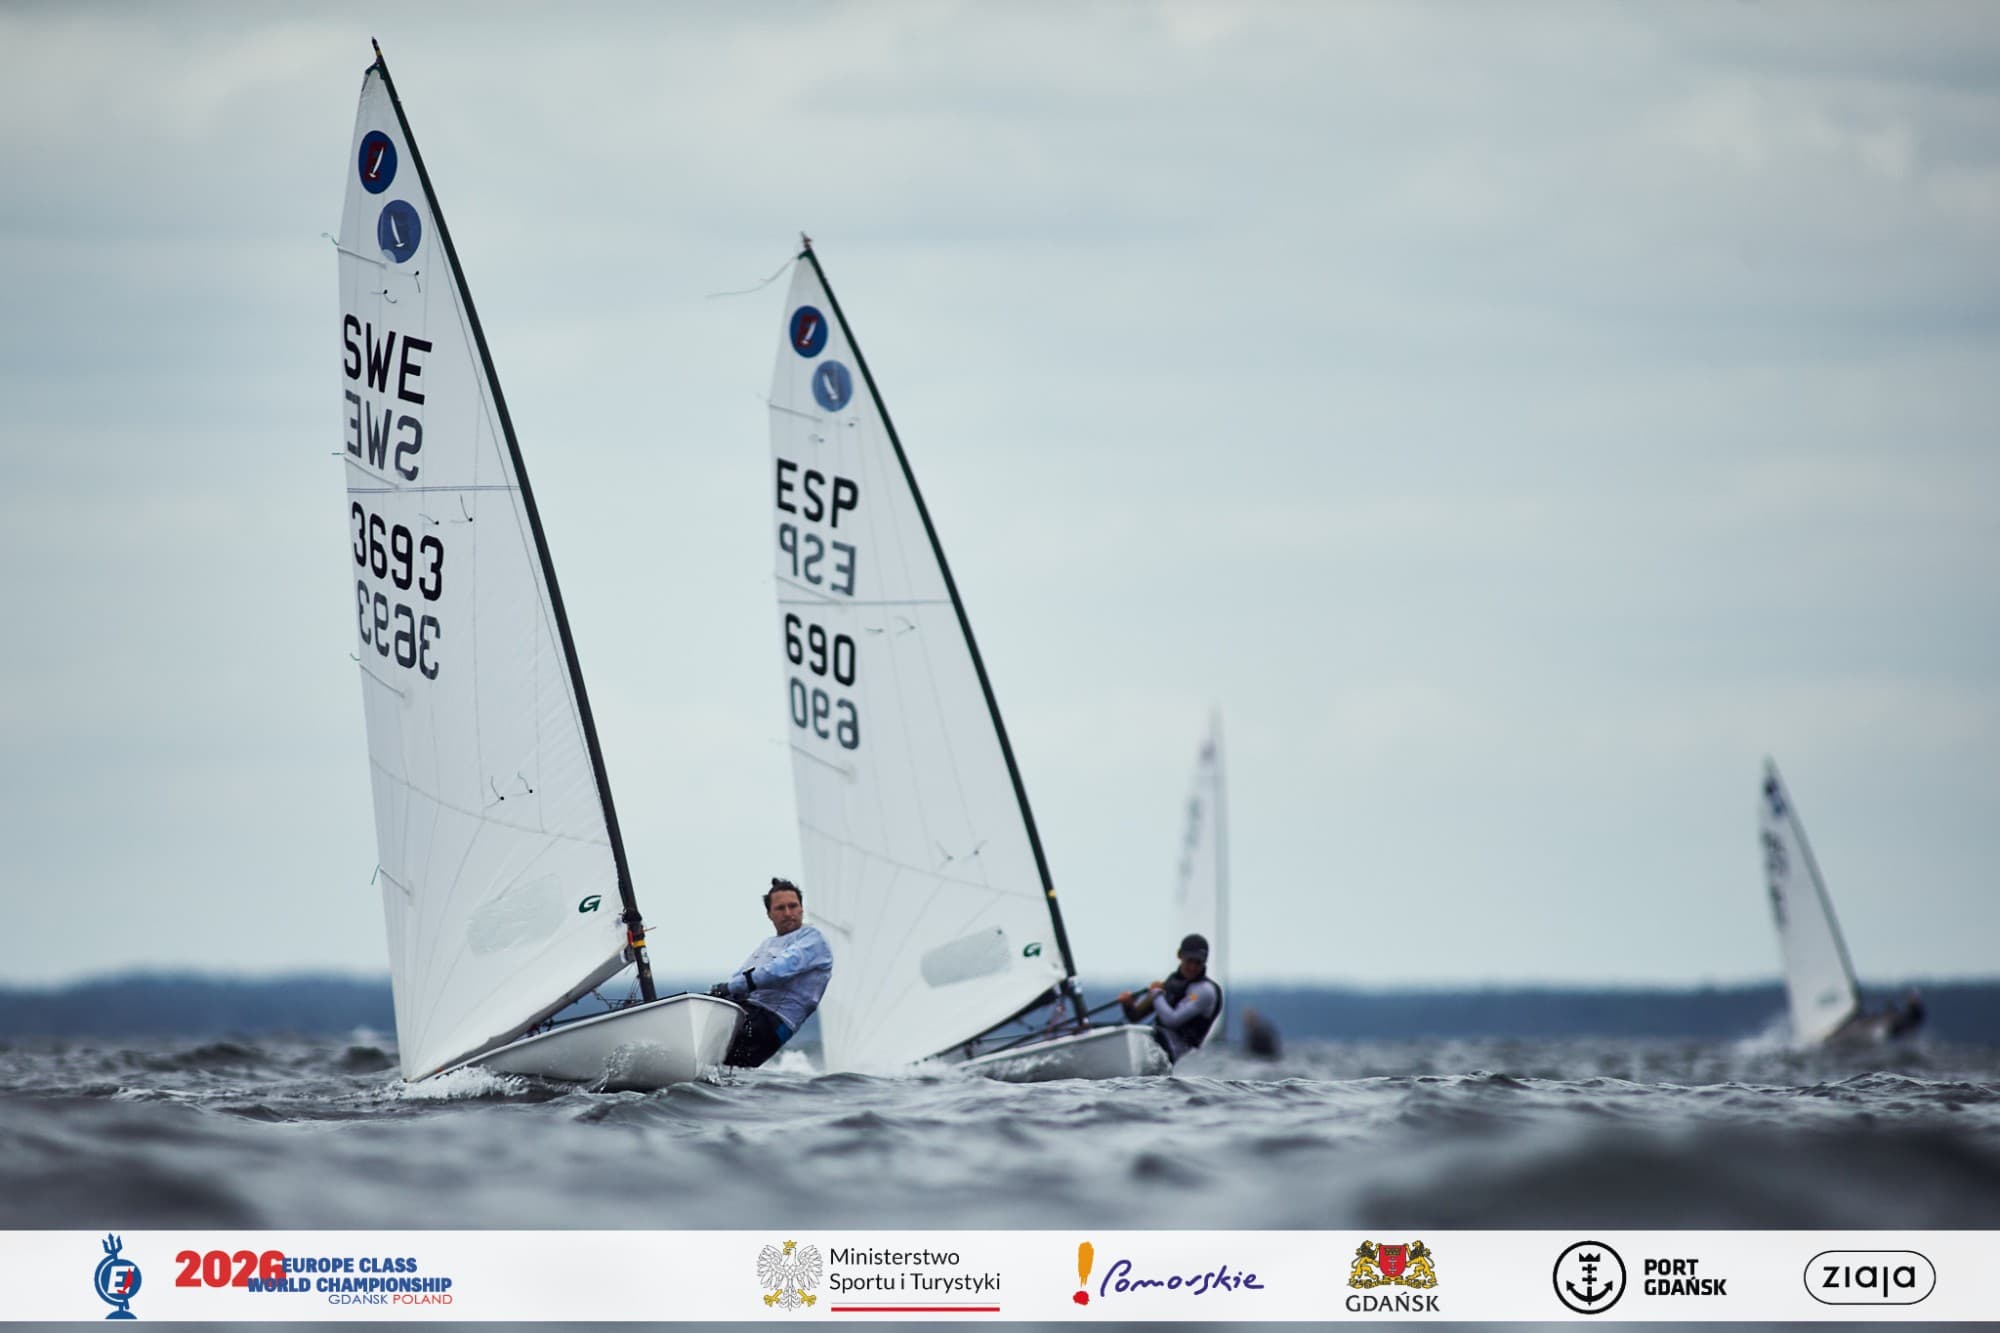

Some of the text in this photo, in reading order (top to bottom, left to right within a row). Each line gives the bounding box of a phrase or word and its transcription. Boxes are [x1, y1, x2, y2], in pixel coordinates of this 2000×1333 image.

[343, 314, 432, 405] SWE
[777, 458, 858, 528] ESP
[352, 501, 444, 601] 3693
[785, 613, 856, 687] 690
